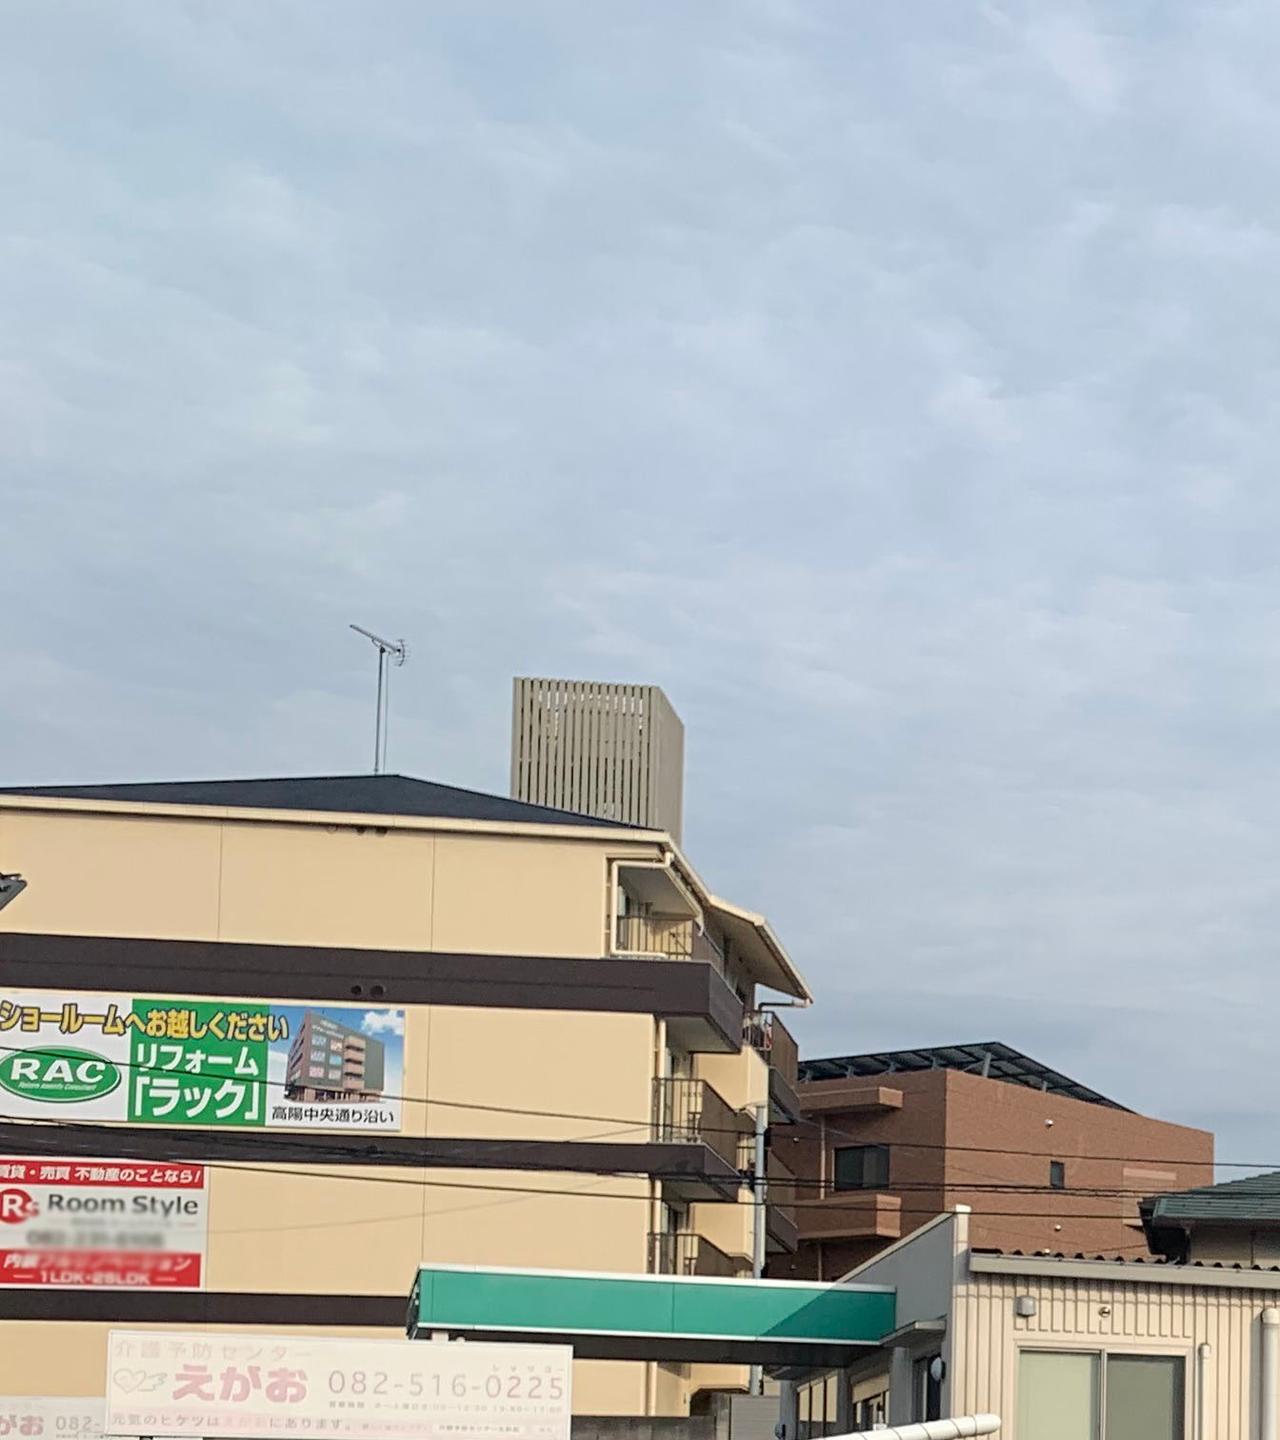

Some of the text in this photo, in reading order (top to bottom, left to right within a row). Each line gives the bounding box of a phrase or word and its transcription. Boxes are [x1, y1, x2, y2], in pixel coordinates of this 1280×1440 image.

[0, 1000, 289, 1041] ショールームへお越しください
[11, 1058, 106, 1083] RAC
[137, 1043, 259, 1076] リフォーム
[134, 1076, 259, 1120] 「ラック」
[271, 1106, 394, 1123] 高陽中央通り沿い
[48, 1194, 198, 1218] Room Style
[173, 1364, 307, 1403] えがお
[328, 1370, 564, 1400] 082-516-0225
